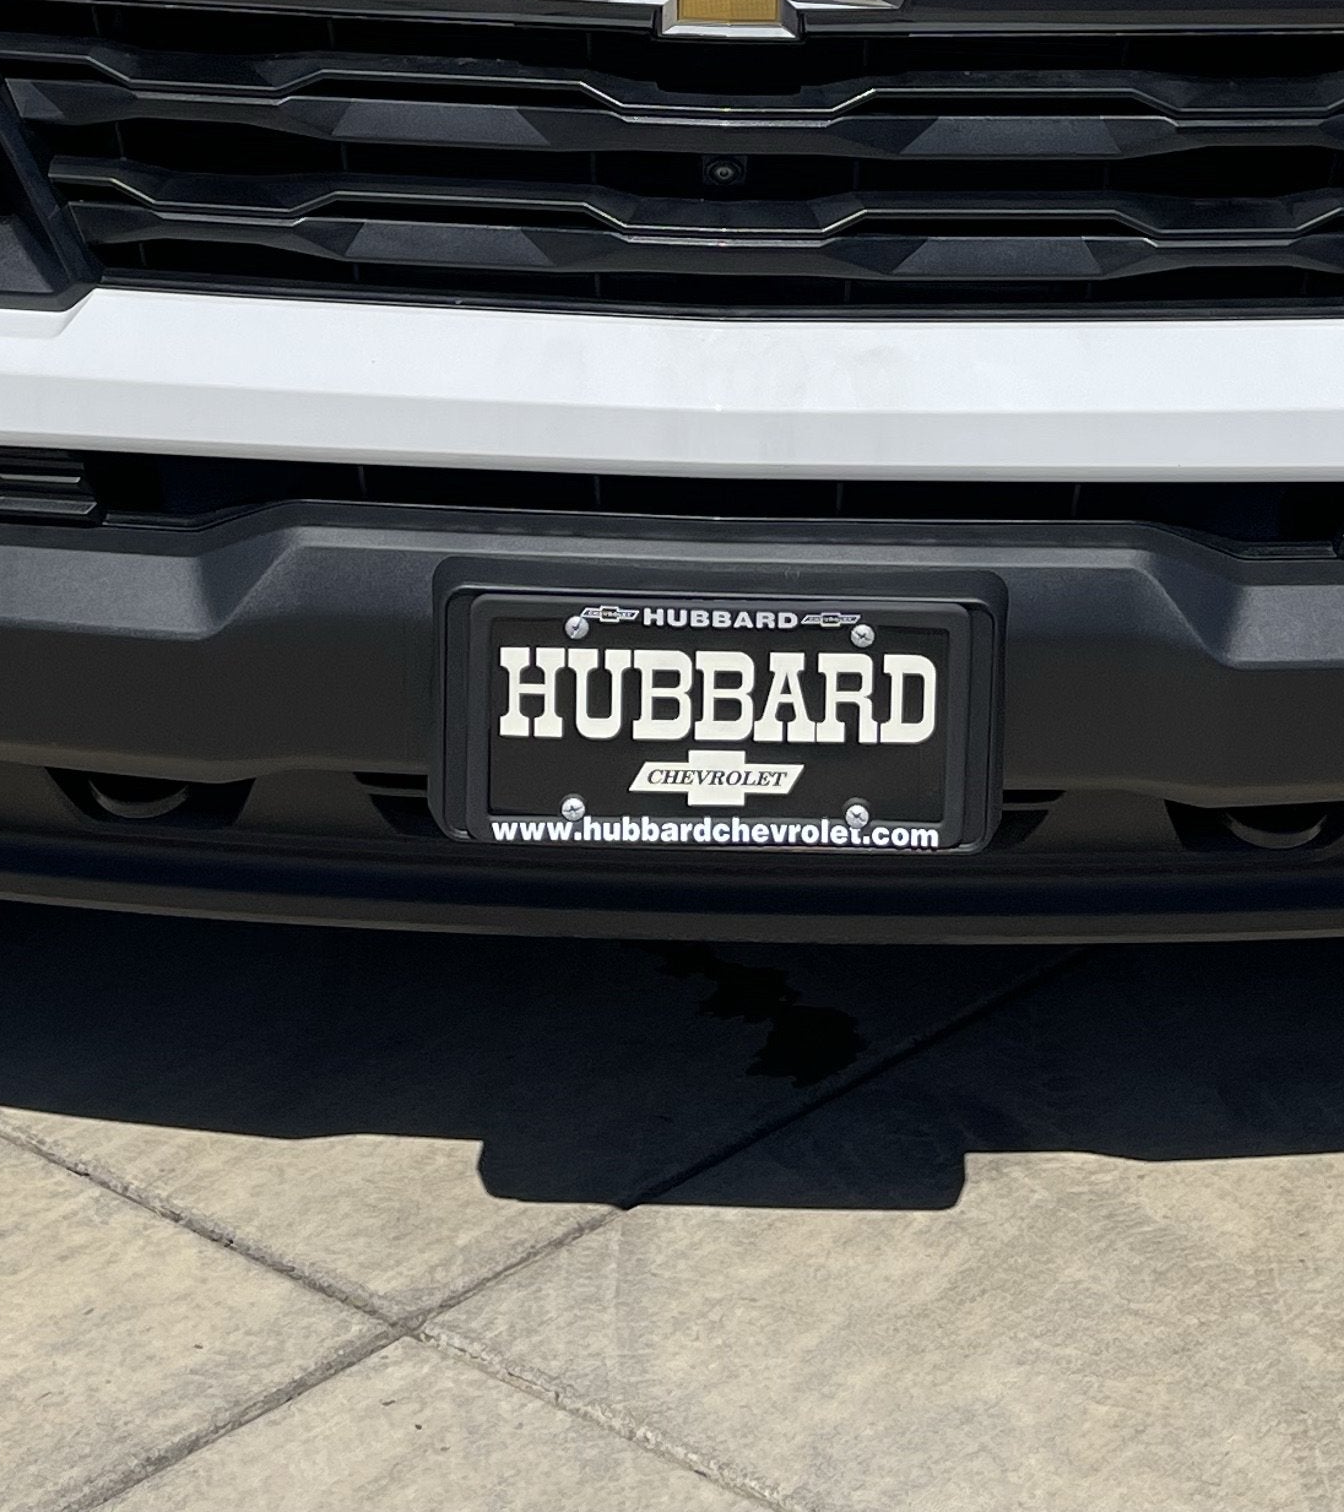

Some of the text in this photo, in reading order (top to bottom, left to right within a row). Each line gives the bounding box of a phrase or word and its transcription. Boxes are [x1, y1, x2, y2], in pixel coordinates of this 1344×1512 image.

[643, 607, 799, 629] HUBBARD
[499, 646, 937, 744] HUBBARD
[647, 768, 788, 787] CHEVROLET
[491, 815, 939, 848] www.hubbardchevrolet.com
